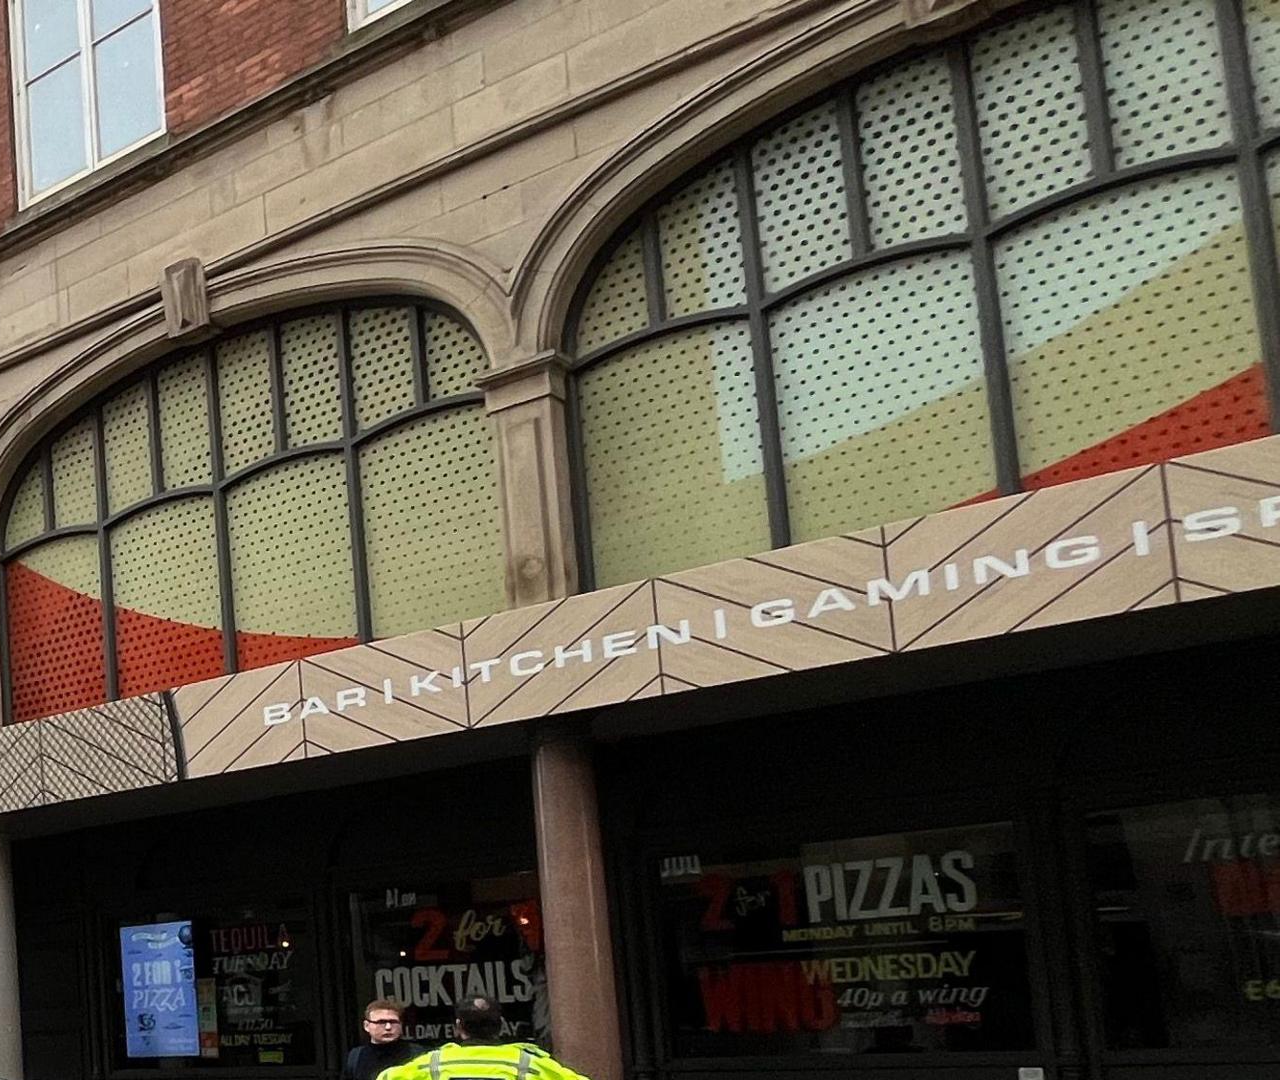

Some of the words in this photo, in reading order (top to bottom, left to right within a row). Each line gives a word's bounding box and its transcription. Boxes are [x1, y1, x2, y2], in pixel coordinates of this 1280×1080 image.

[263, 686, 366, 726] BAR
[410, 620, 692, 696] KITCHEN
[751, 536, 1101, 629] GAMING
[803, 849, 978, 924] PIZZAS
[208, 923, 290, 954] TEQUILA
[453, 908, 507, 952] for
[782, 925, 856, 942] MONDAY
[864, 920, 920, 937] UNTIL
[131, 962, 142, 987] 2
[210, 950, 294, 975] TUESDAY
[800, 950, 977, 984] WEDNESDAY
[132, 986, 186, 1013] PIZZA
[375, 958, 535, 1010] COCKTAILS
[837, 986, 884, 1010] 40p
[890, 989, 910, 1006] a
[918, 983, 991, 1008] wing
